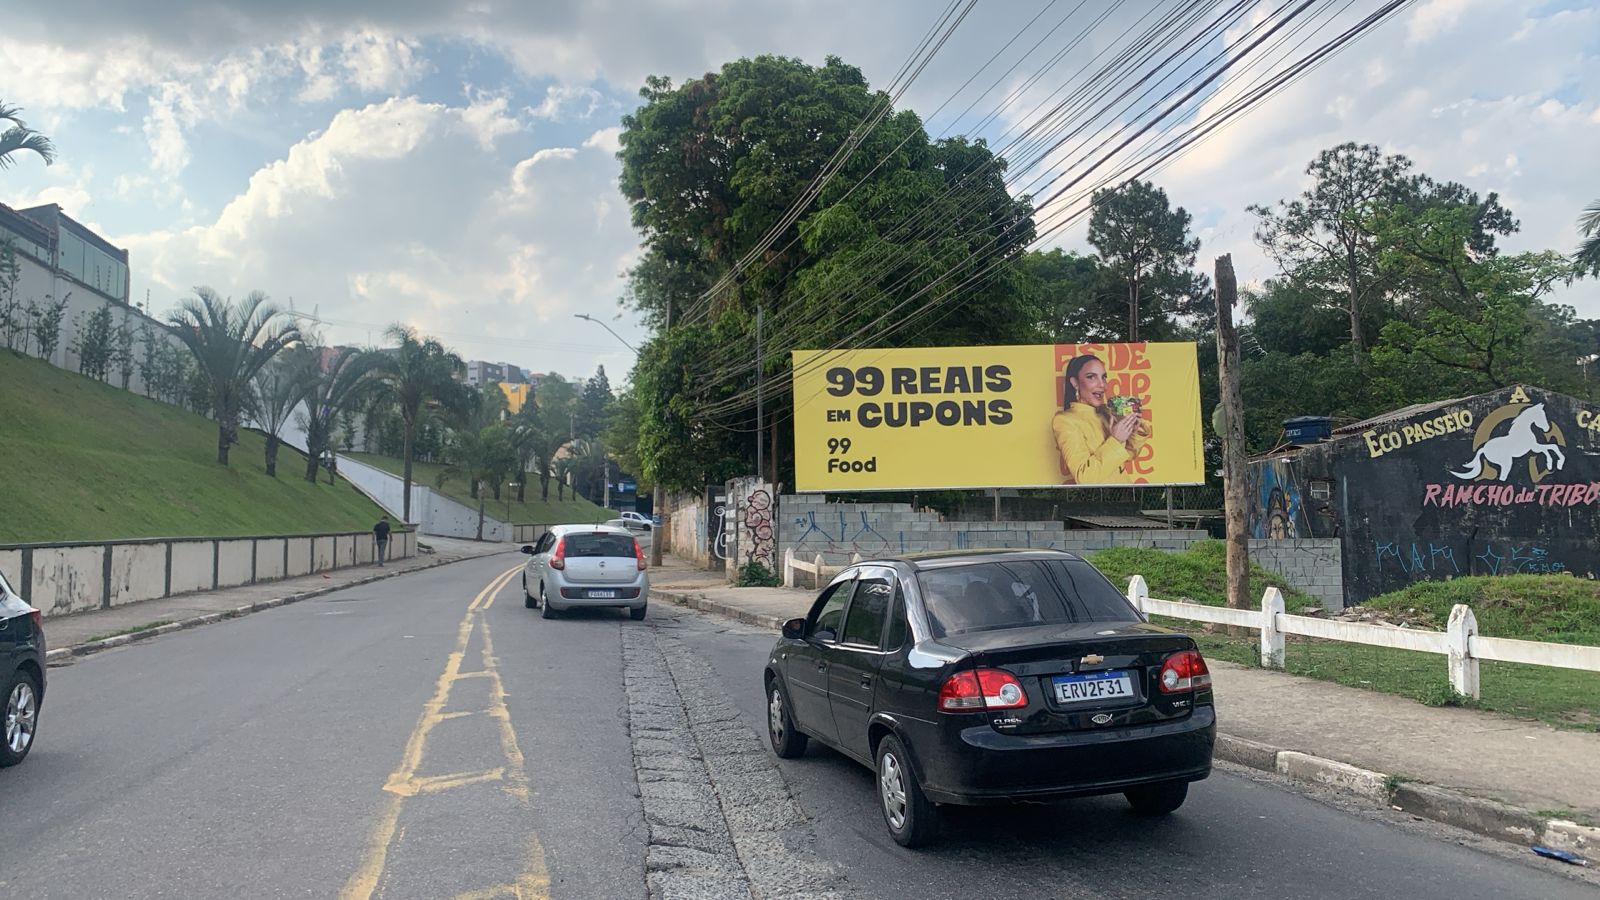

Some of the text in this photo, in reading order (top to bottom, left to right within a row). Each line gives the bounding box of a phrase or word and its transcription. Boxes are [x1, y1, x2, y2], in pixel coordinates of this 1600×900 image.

[826, 365, 1012, 397] 99 REAIS
[1509, 386, 1531, 404] A
[827, 399, 1013, 428] EM CUPONS
[1402, 409, 1473, 445] PASSEIO
[827, 438, 852, 454] 99
[828, 457, 876, 473] Food
[1423, 484, 1514, 509] RANCHO
[1515, 487, 1535, 504] da
[1061, 680, 1125, 699] ERV2F31
